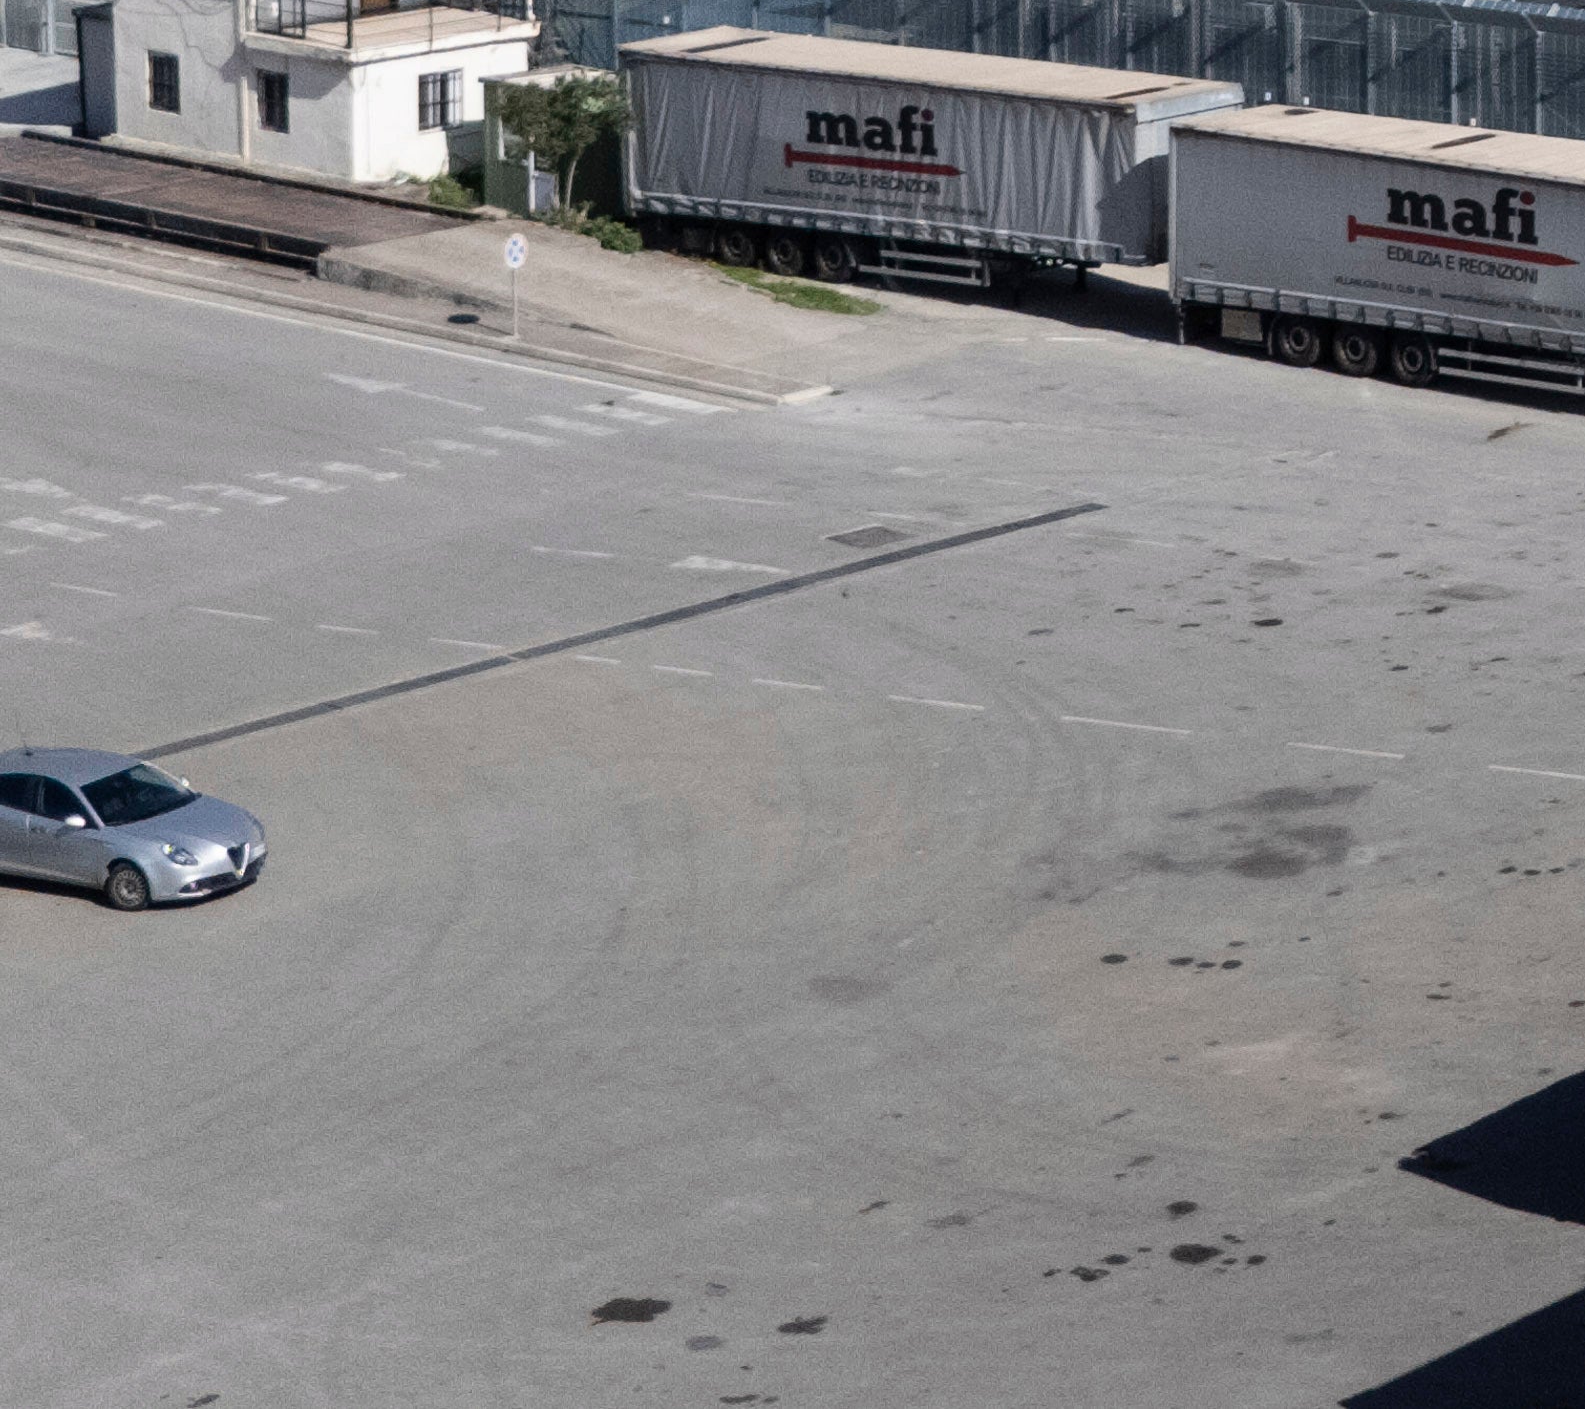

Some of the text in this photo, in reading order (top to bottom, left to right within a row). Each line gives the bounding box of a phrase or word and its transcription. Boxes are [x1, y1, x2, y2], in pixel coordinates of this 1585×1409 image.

[806, 104, 938, 157] mafi
[1386, 187, 1539, 245] mafi
[1387, 245, 1539, 284] EDILIZIA E RECINZIONI
